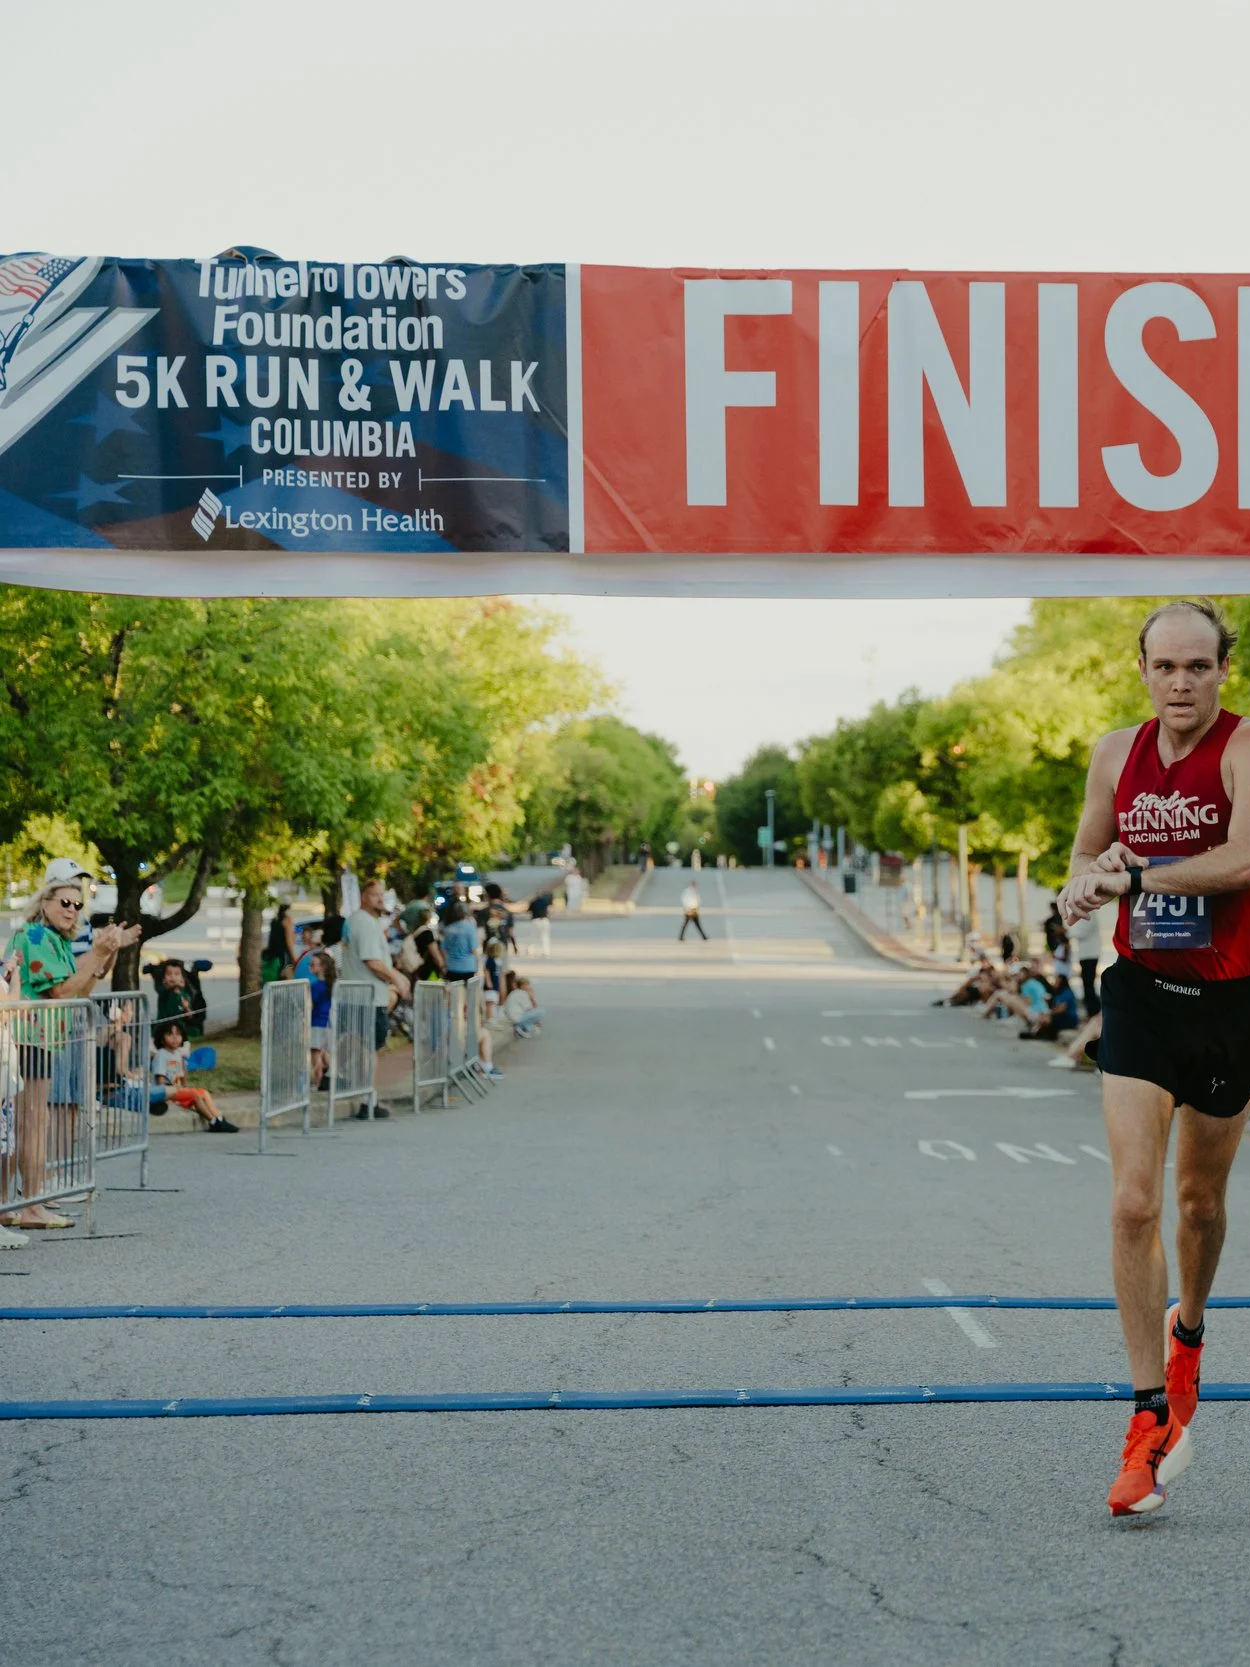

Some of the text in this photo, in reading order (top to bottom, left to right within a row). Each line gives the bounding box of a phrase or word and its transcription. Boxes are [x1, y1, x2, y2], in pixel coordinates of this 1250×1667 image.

[195, 257, 309, 300] Tunnel
[311, 267, 338, 293] TO
[212, 305, 443, 351] Foundation
[115, 355, 541, 413] 5K RUN & WALK
[250, 416, 417, 458] COLUMBIA
[262, 468, 403, 489] PRESENTED BY
[225, 504, 445, 538] Lexington Health
[1132, 790, 1200, 812] Strictly
[1118, 804, 1219, 832] RUNNING
[1128, 829, 1200, 844] RACING TEAM
[1151, 931, 1175, 939] Lexington
